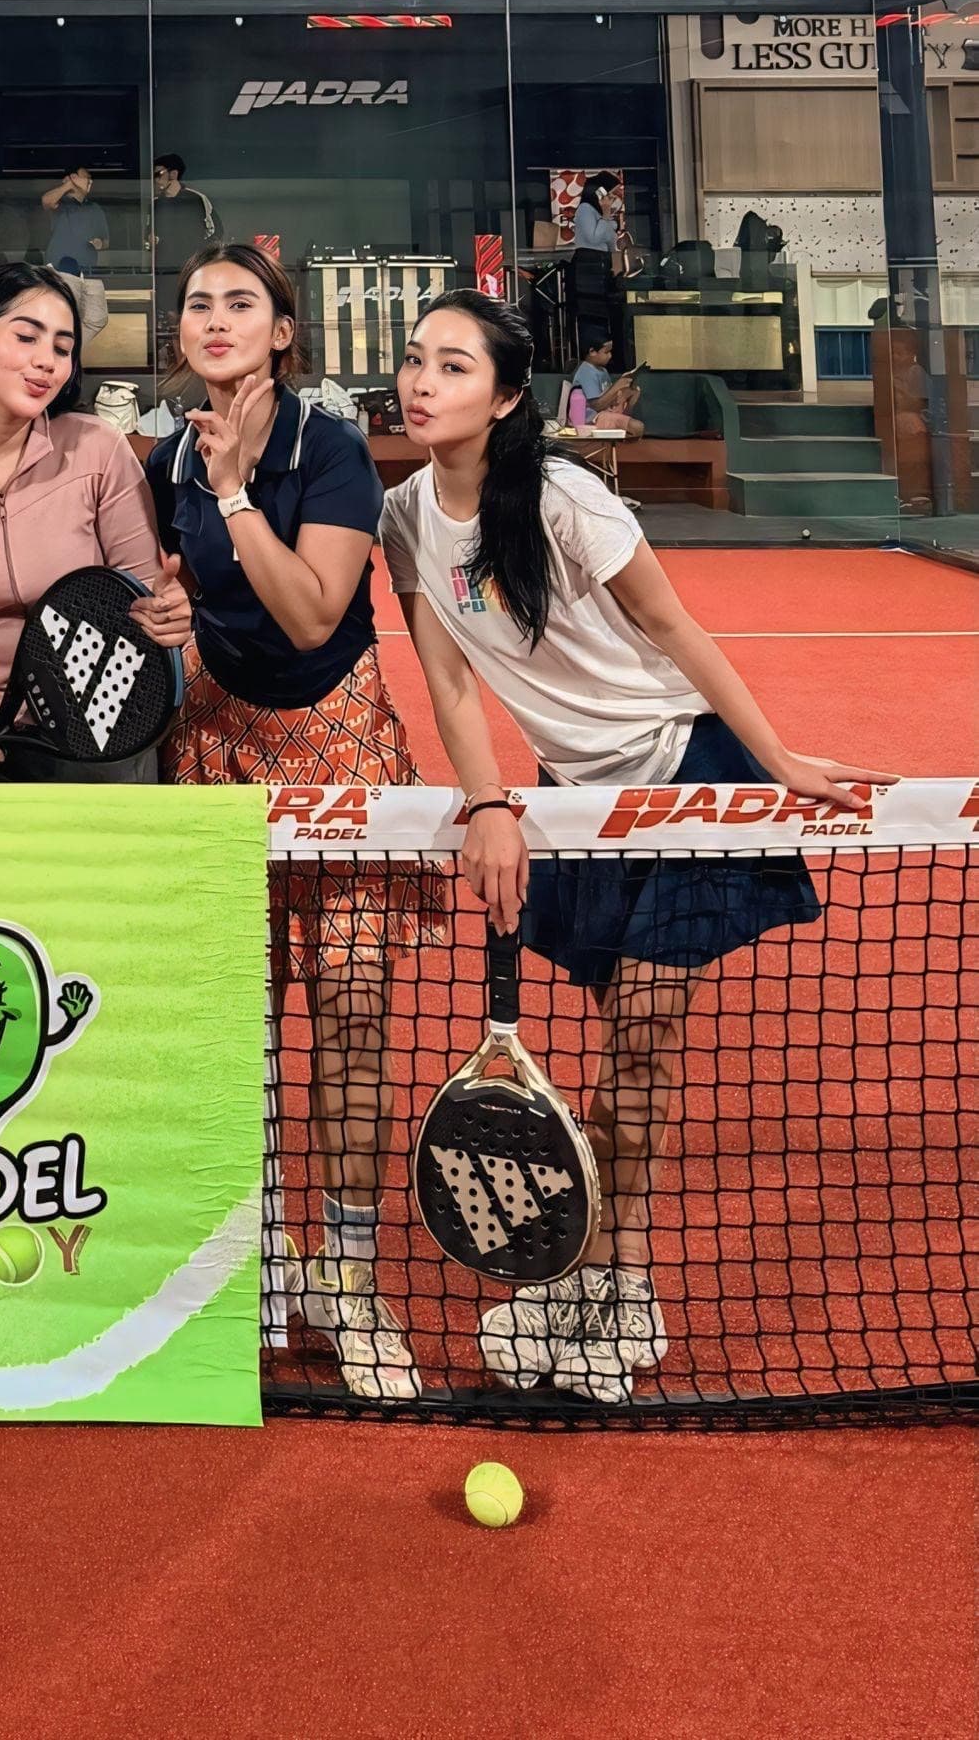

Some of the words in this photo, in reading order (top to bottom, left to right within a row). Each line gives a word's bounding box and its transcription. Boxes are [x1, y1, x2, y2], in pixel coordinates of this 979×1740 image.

[773, 17, 841, 38] MORE
[732, 43, 812, 70] LESS
[229, 80, 409, 116] PADRA
[294, 827, 367, 841] PADEL
[800, 823, 873, 837] PADEL
